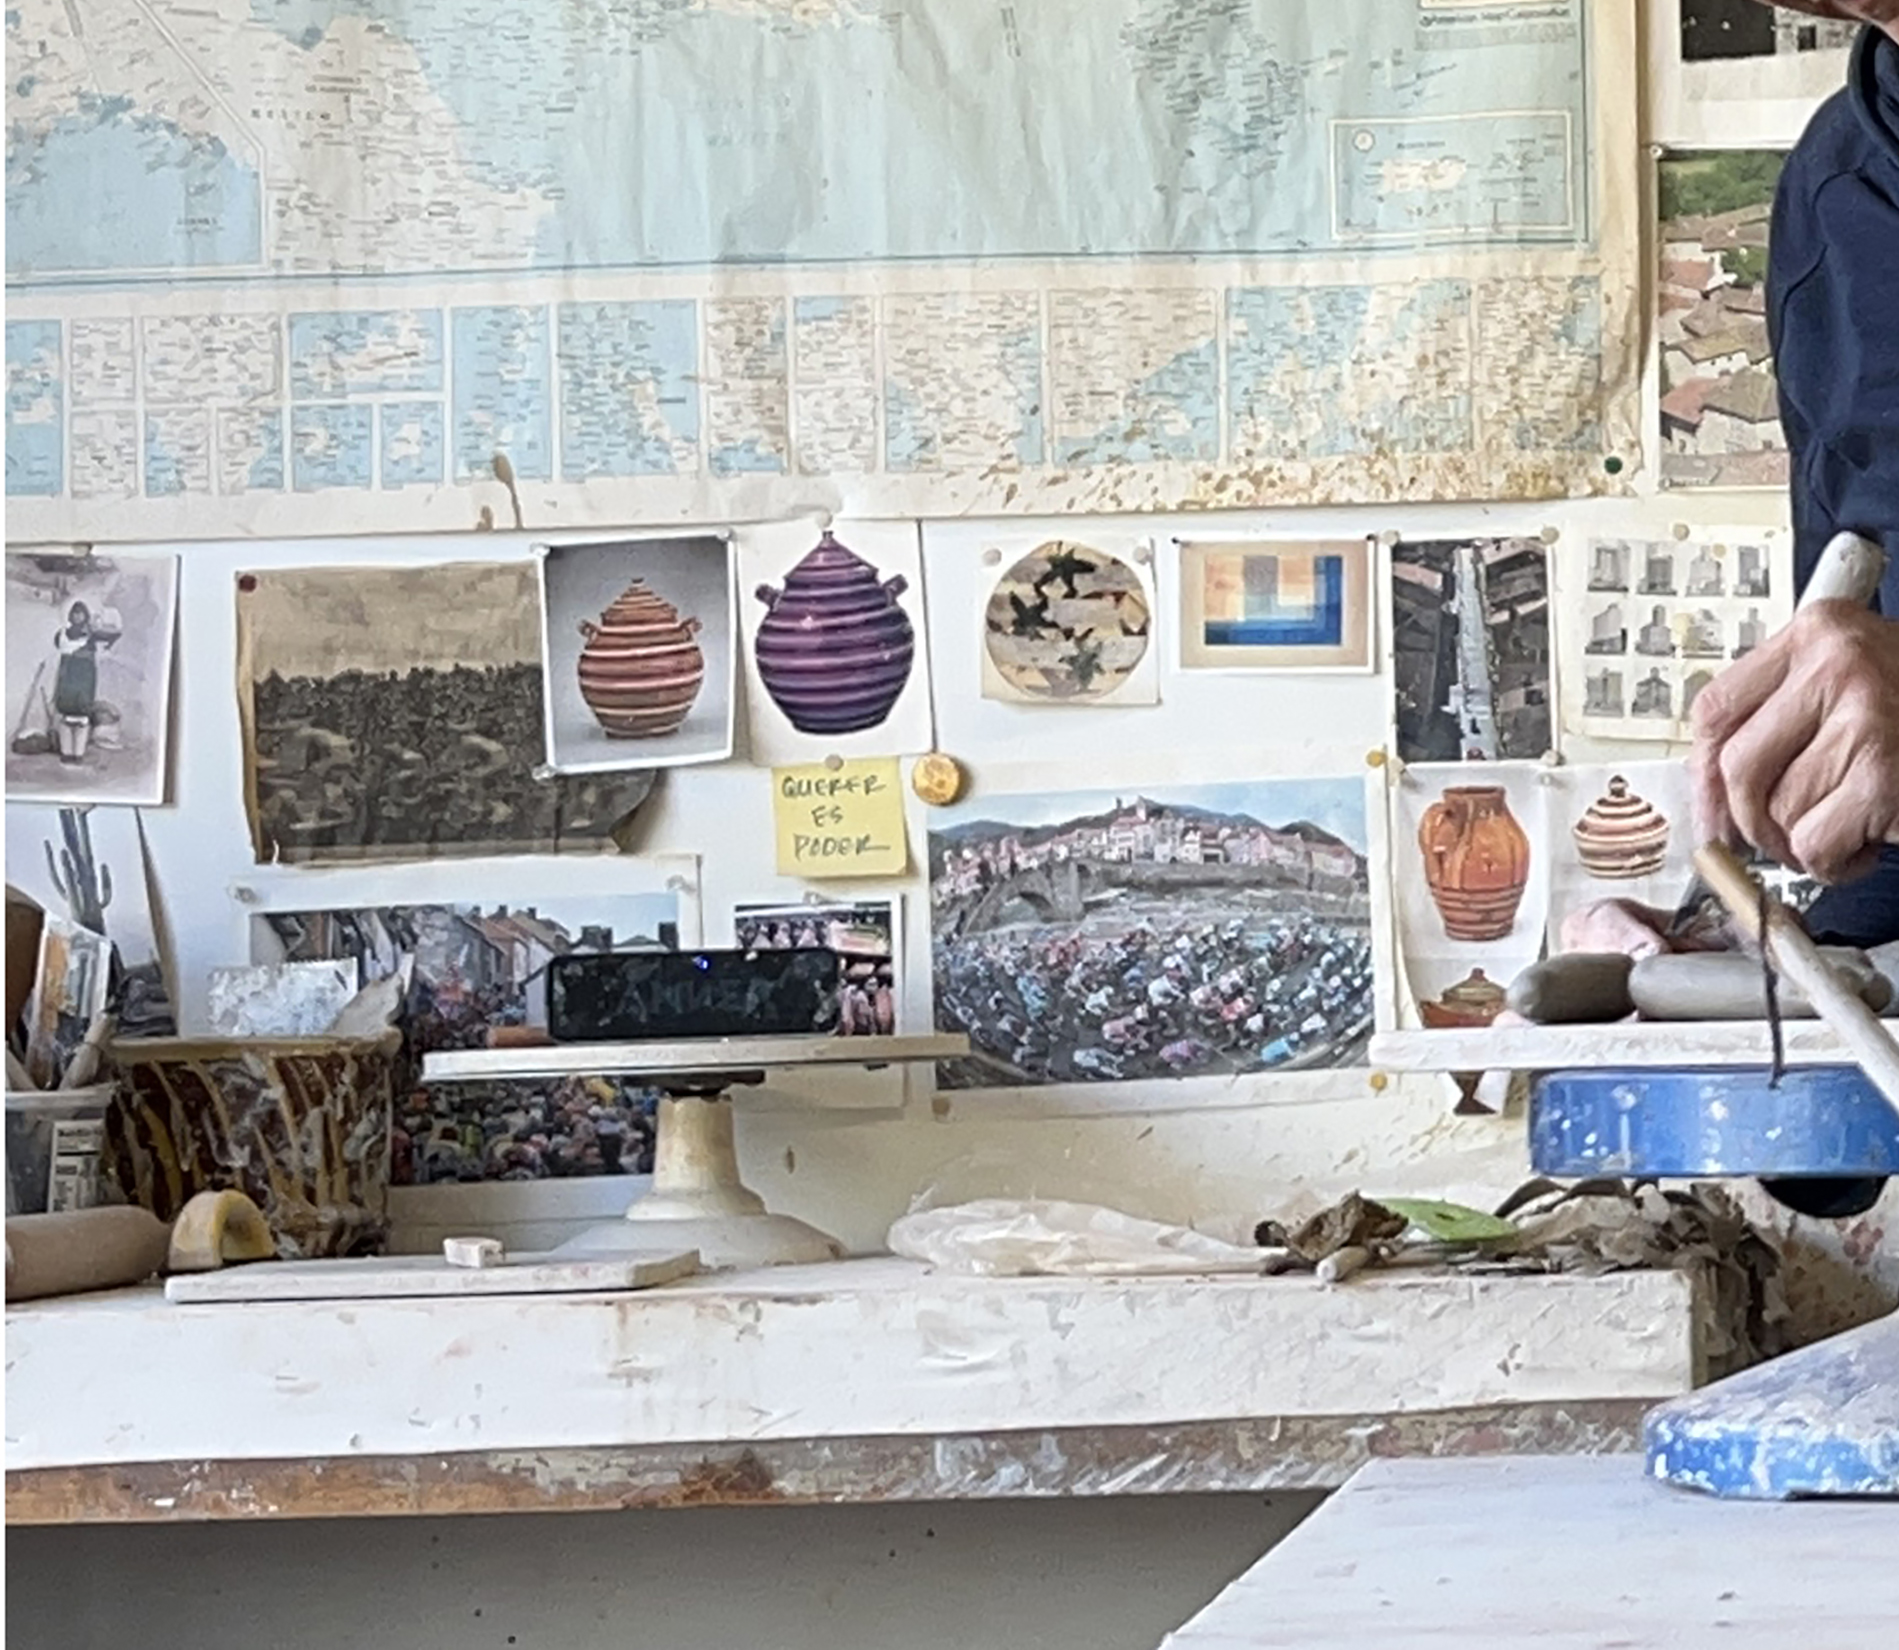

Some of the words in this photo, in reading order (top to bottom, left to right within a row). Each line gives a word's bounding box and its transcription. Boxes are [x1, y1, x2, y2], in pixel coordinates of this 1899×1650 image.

[781, 774, 887, 798] QUERER
[810, 804, 844, 828] ES
[792, 832, 891, 862] PODER
